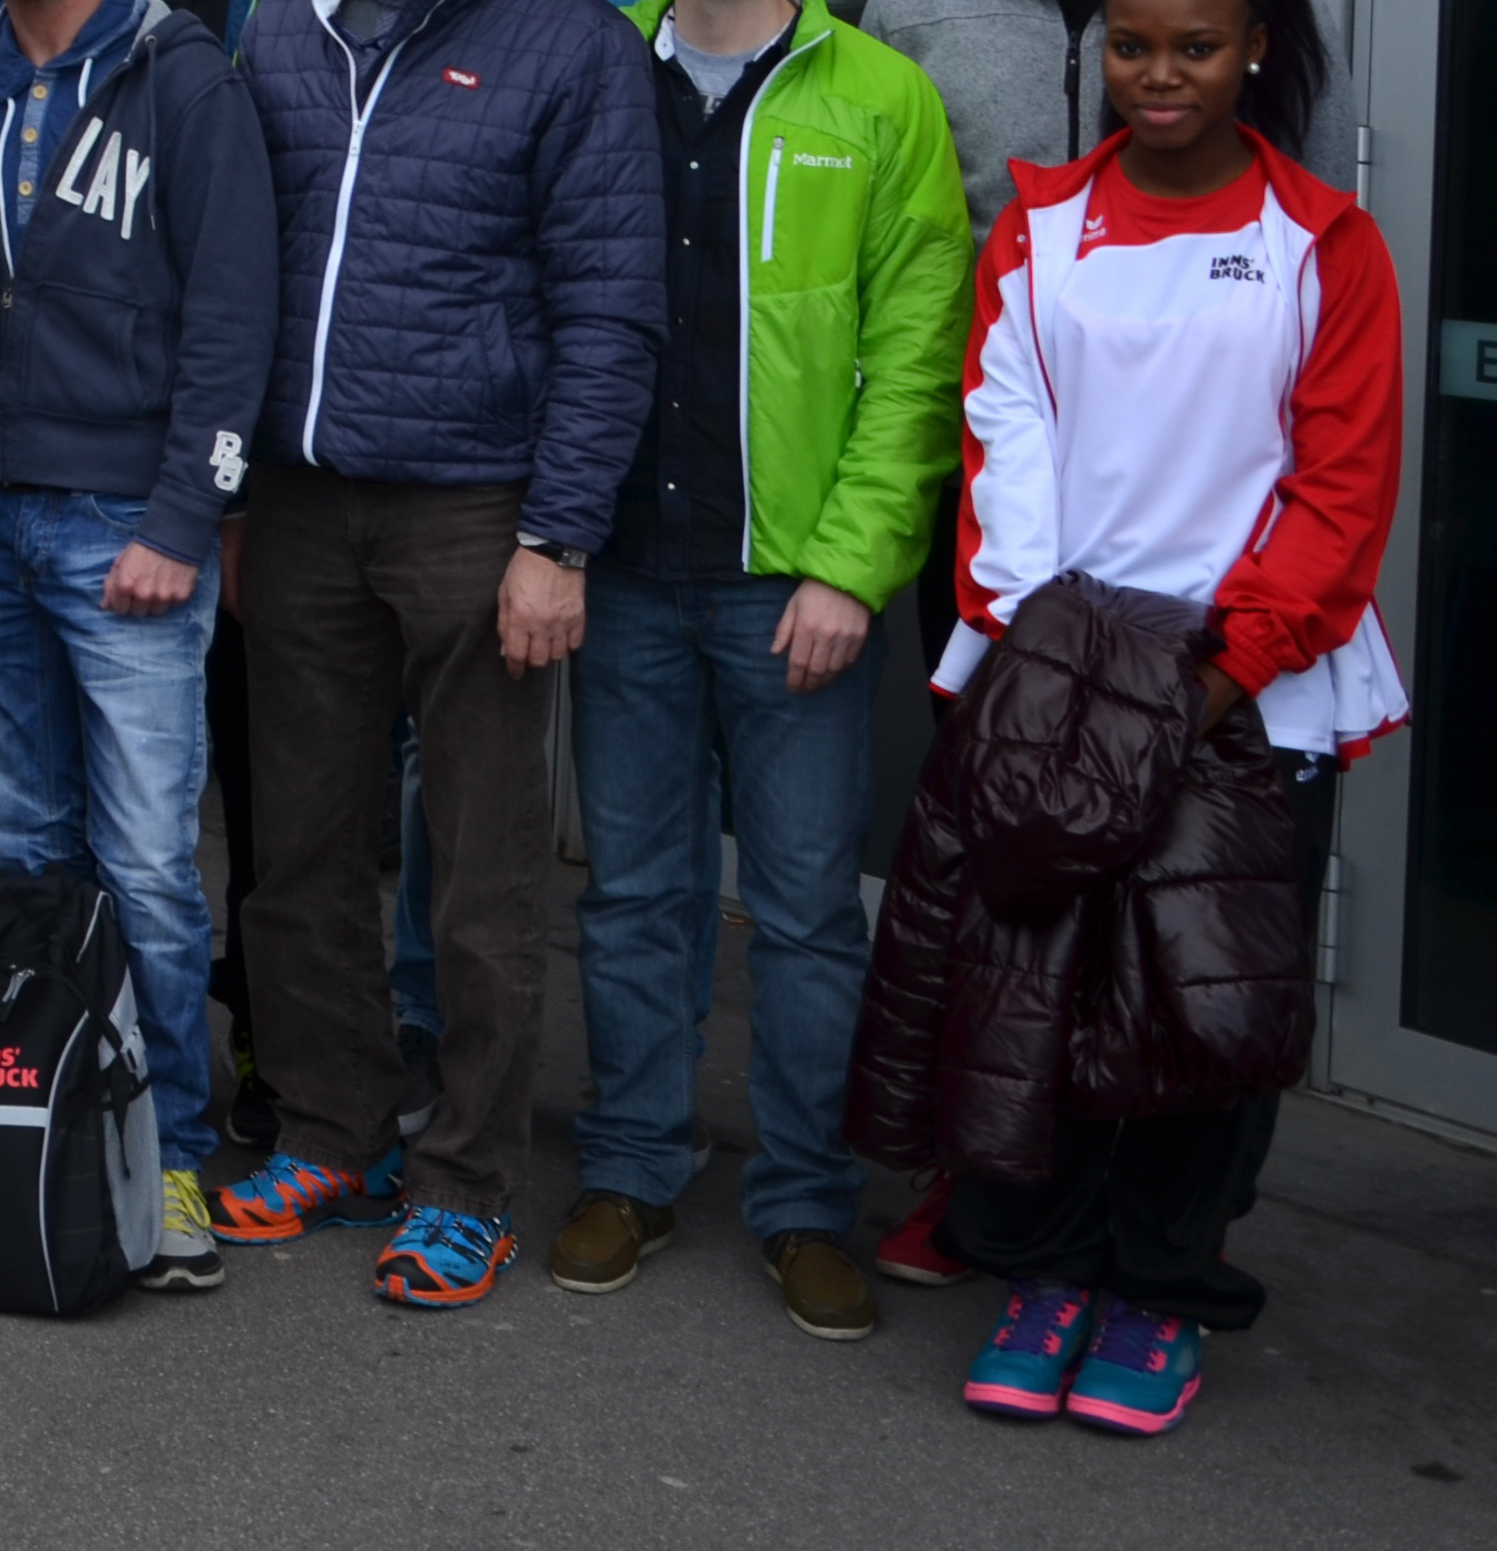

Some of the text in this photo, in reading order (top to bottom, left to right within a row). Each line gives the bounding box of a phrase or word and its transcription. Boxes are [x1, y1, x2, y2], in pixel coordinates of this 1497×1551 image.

[793, 152, 853, 169] Marmot
[1082, 227, 1107, 242] rima
[1209, 267, 1265, 285] BRUCK
